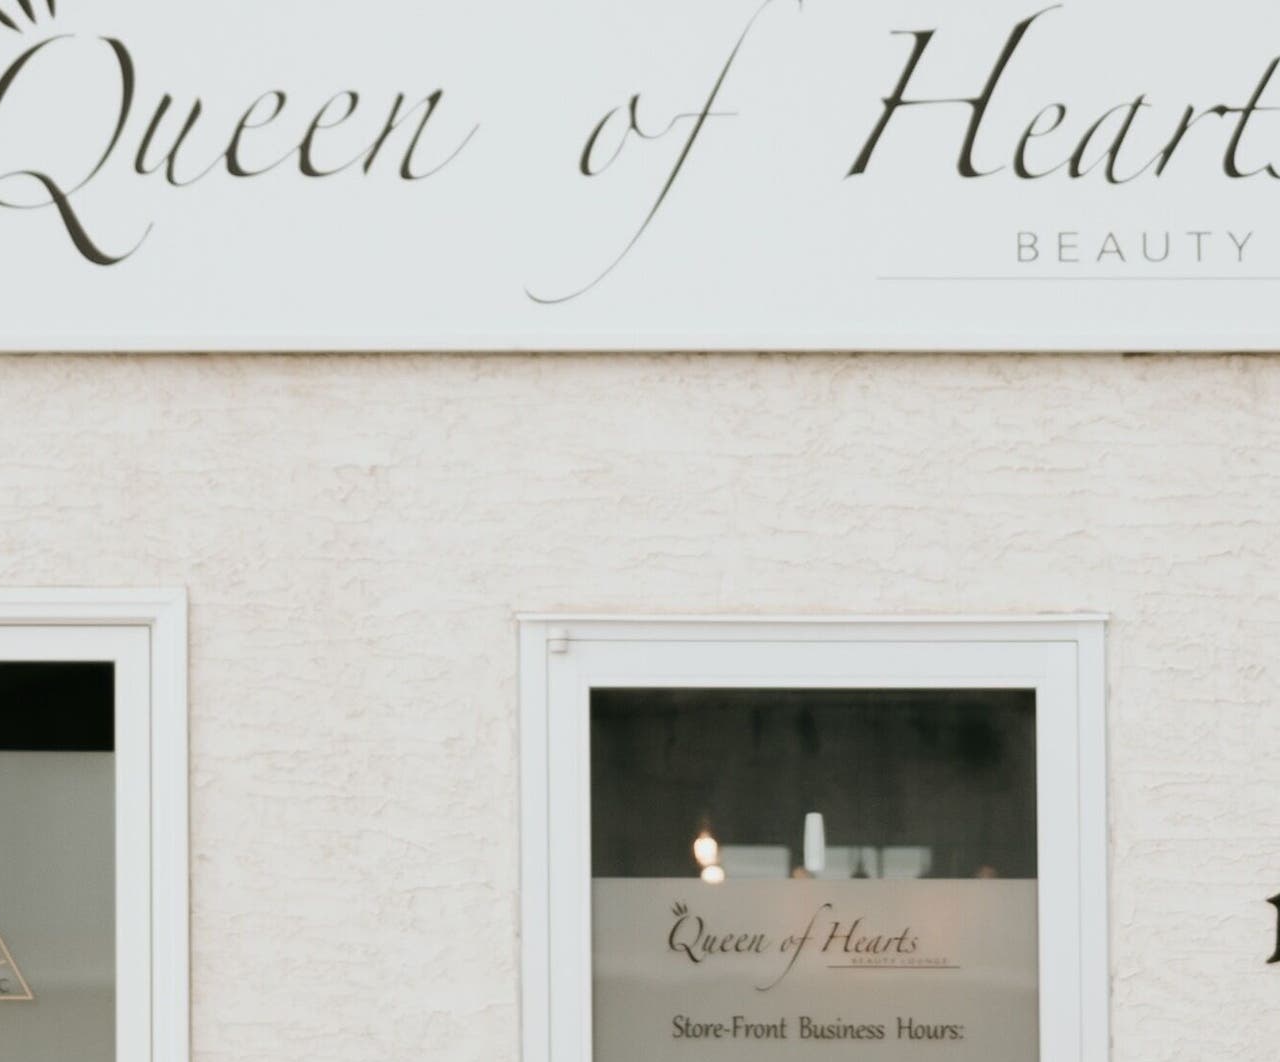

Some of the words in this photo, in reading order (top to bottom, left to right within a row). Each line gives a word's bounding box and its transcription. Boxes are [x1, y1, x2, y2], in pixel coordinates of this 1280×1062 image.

[522, 0, 804, 305] of
[1015, 230, 1256, 265] BEAUTY
[668, 914, 770, 965] Queen
[753, 902, 834, 993] of
[820, 915, 921, 954] Hearts
[671, 1014, 788, 1041] Store-Front
[799, 1015, 886, 1041] Business
[896, 1016, 965, 1041] Hours:
